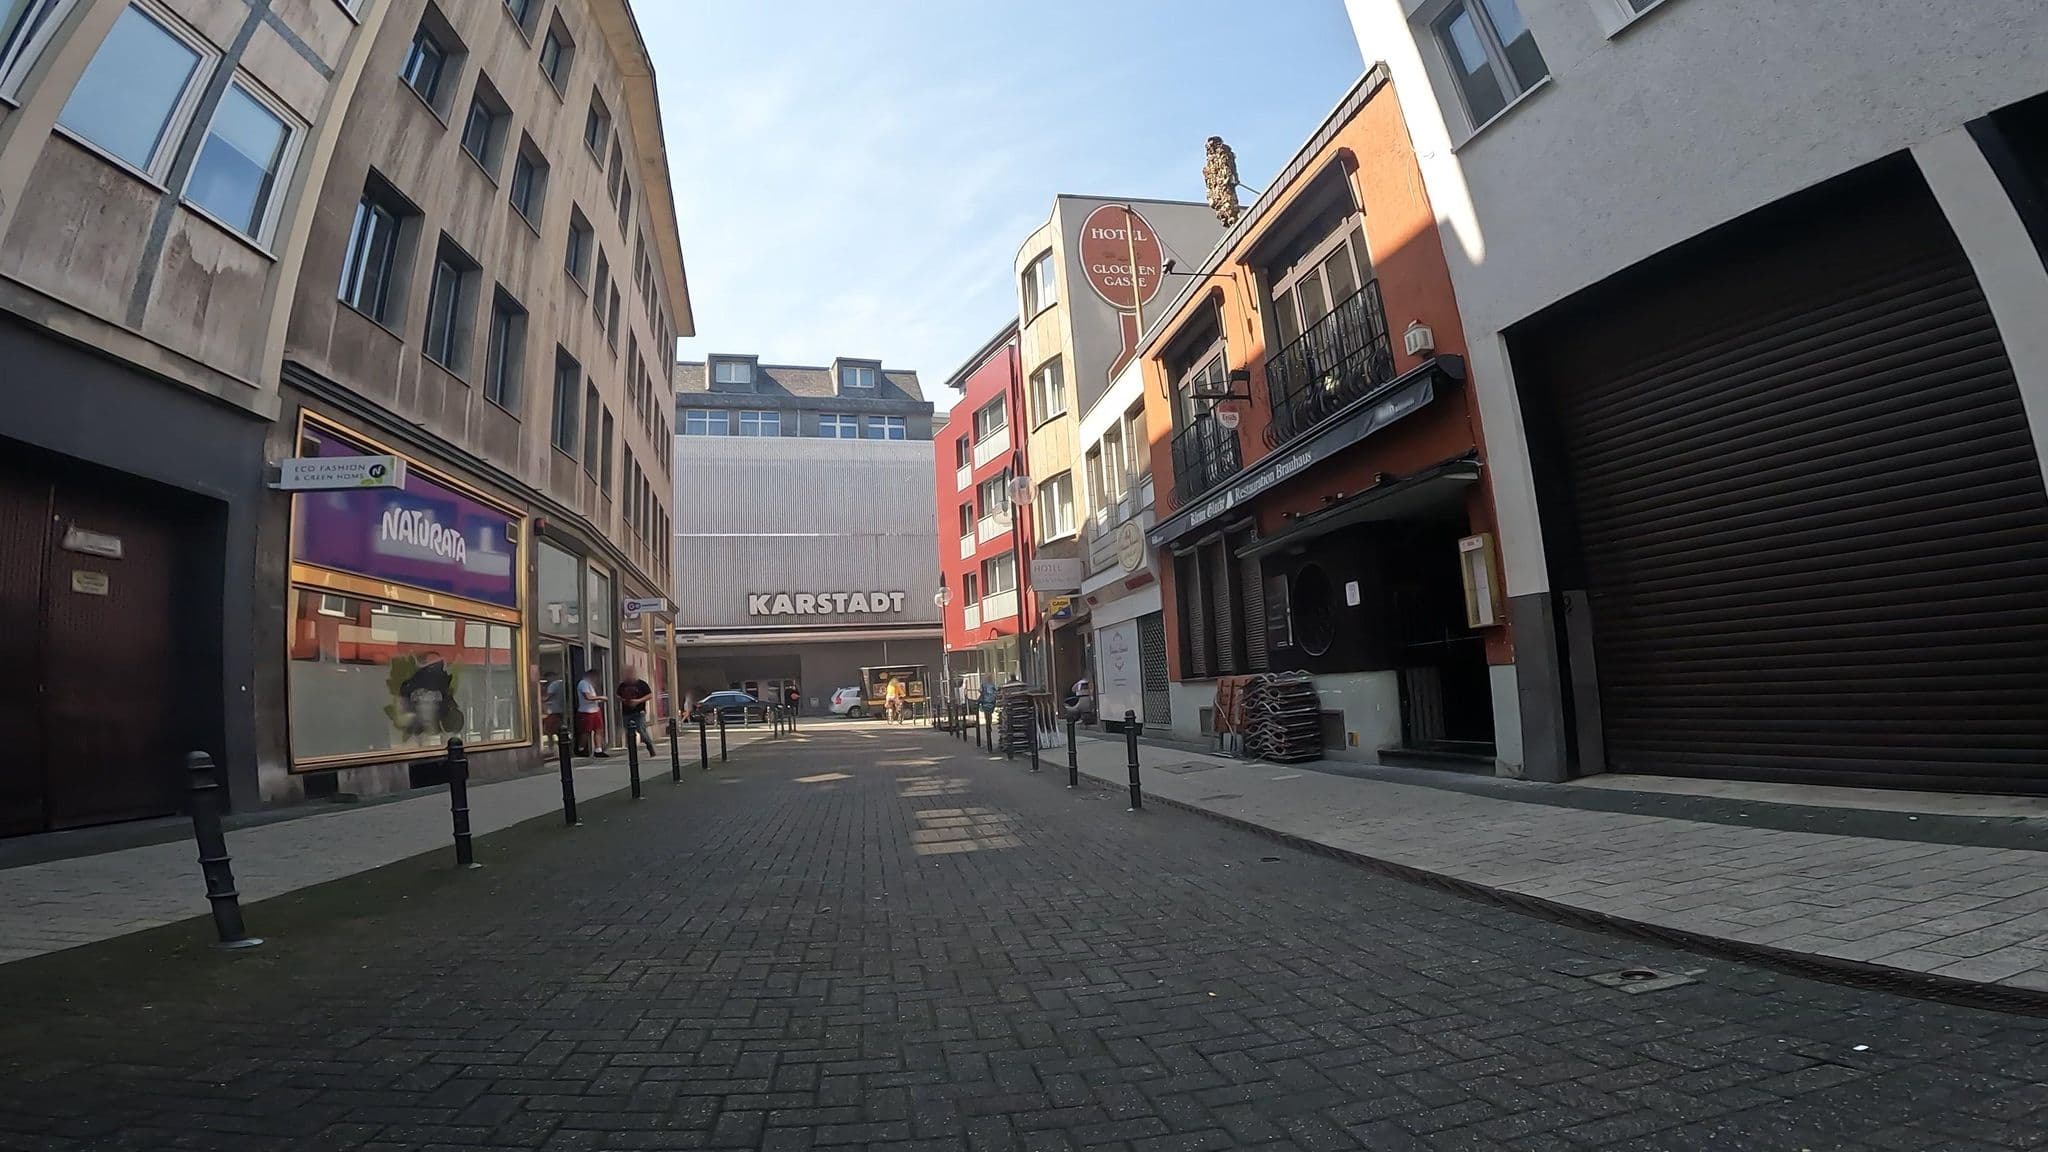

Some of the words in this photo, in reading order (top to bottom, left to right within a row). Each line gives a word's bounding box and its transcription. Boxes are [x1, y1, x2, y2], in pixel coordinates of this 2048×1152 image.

[1091, 228, 1147, 241] HOTL
[1092, 264, 1156, 276] GLOCEN
[294, 464, 316, 473] ECO
[320, 463, 366, 472] FASHION
[1275, 451, 1312, 479] Brauhaus
[382, 508, 466, 565] NATURATA
[748, 592, 905, 616] KARSTADT
